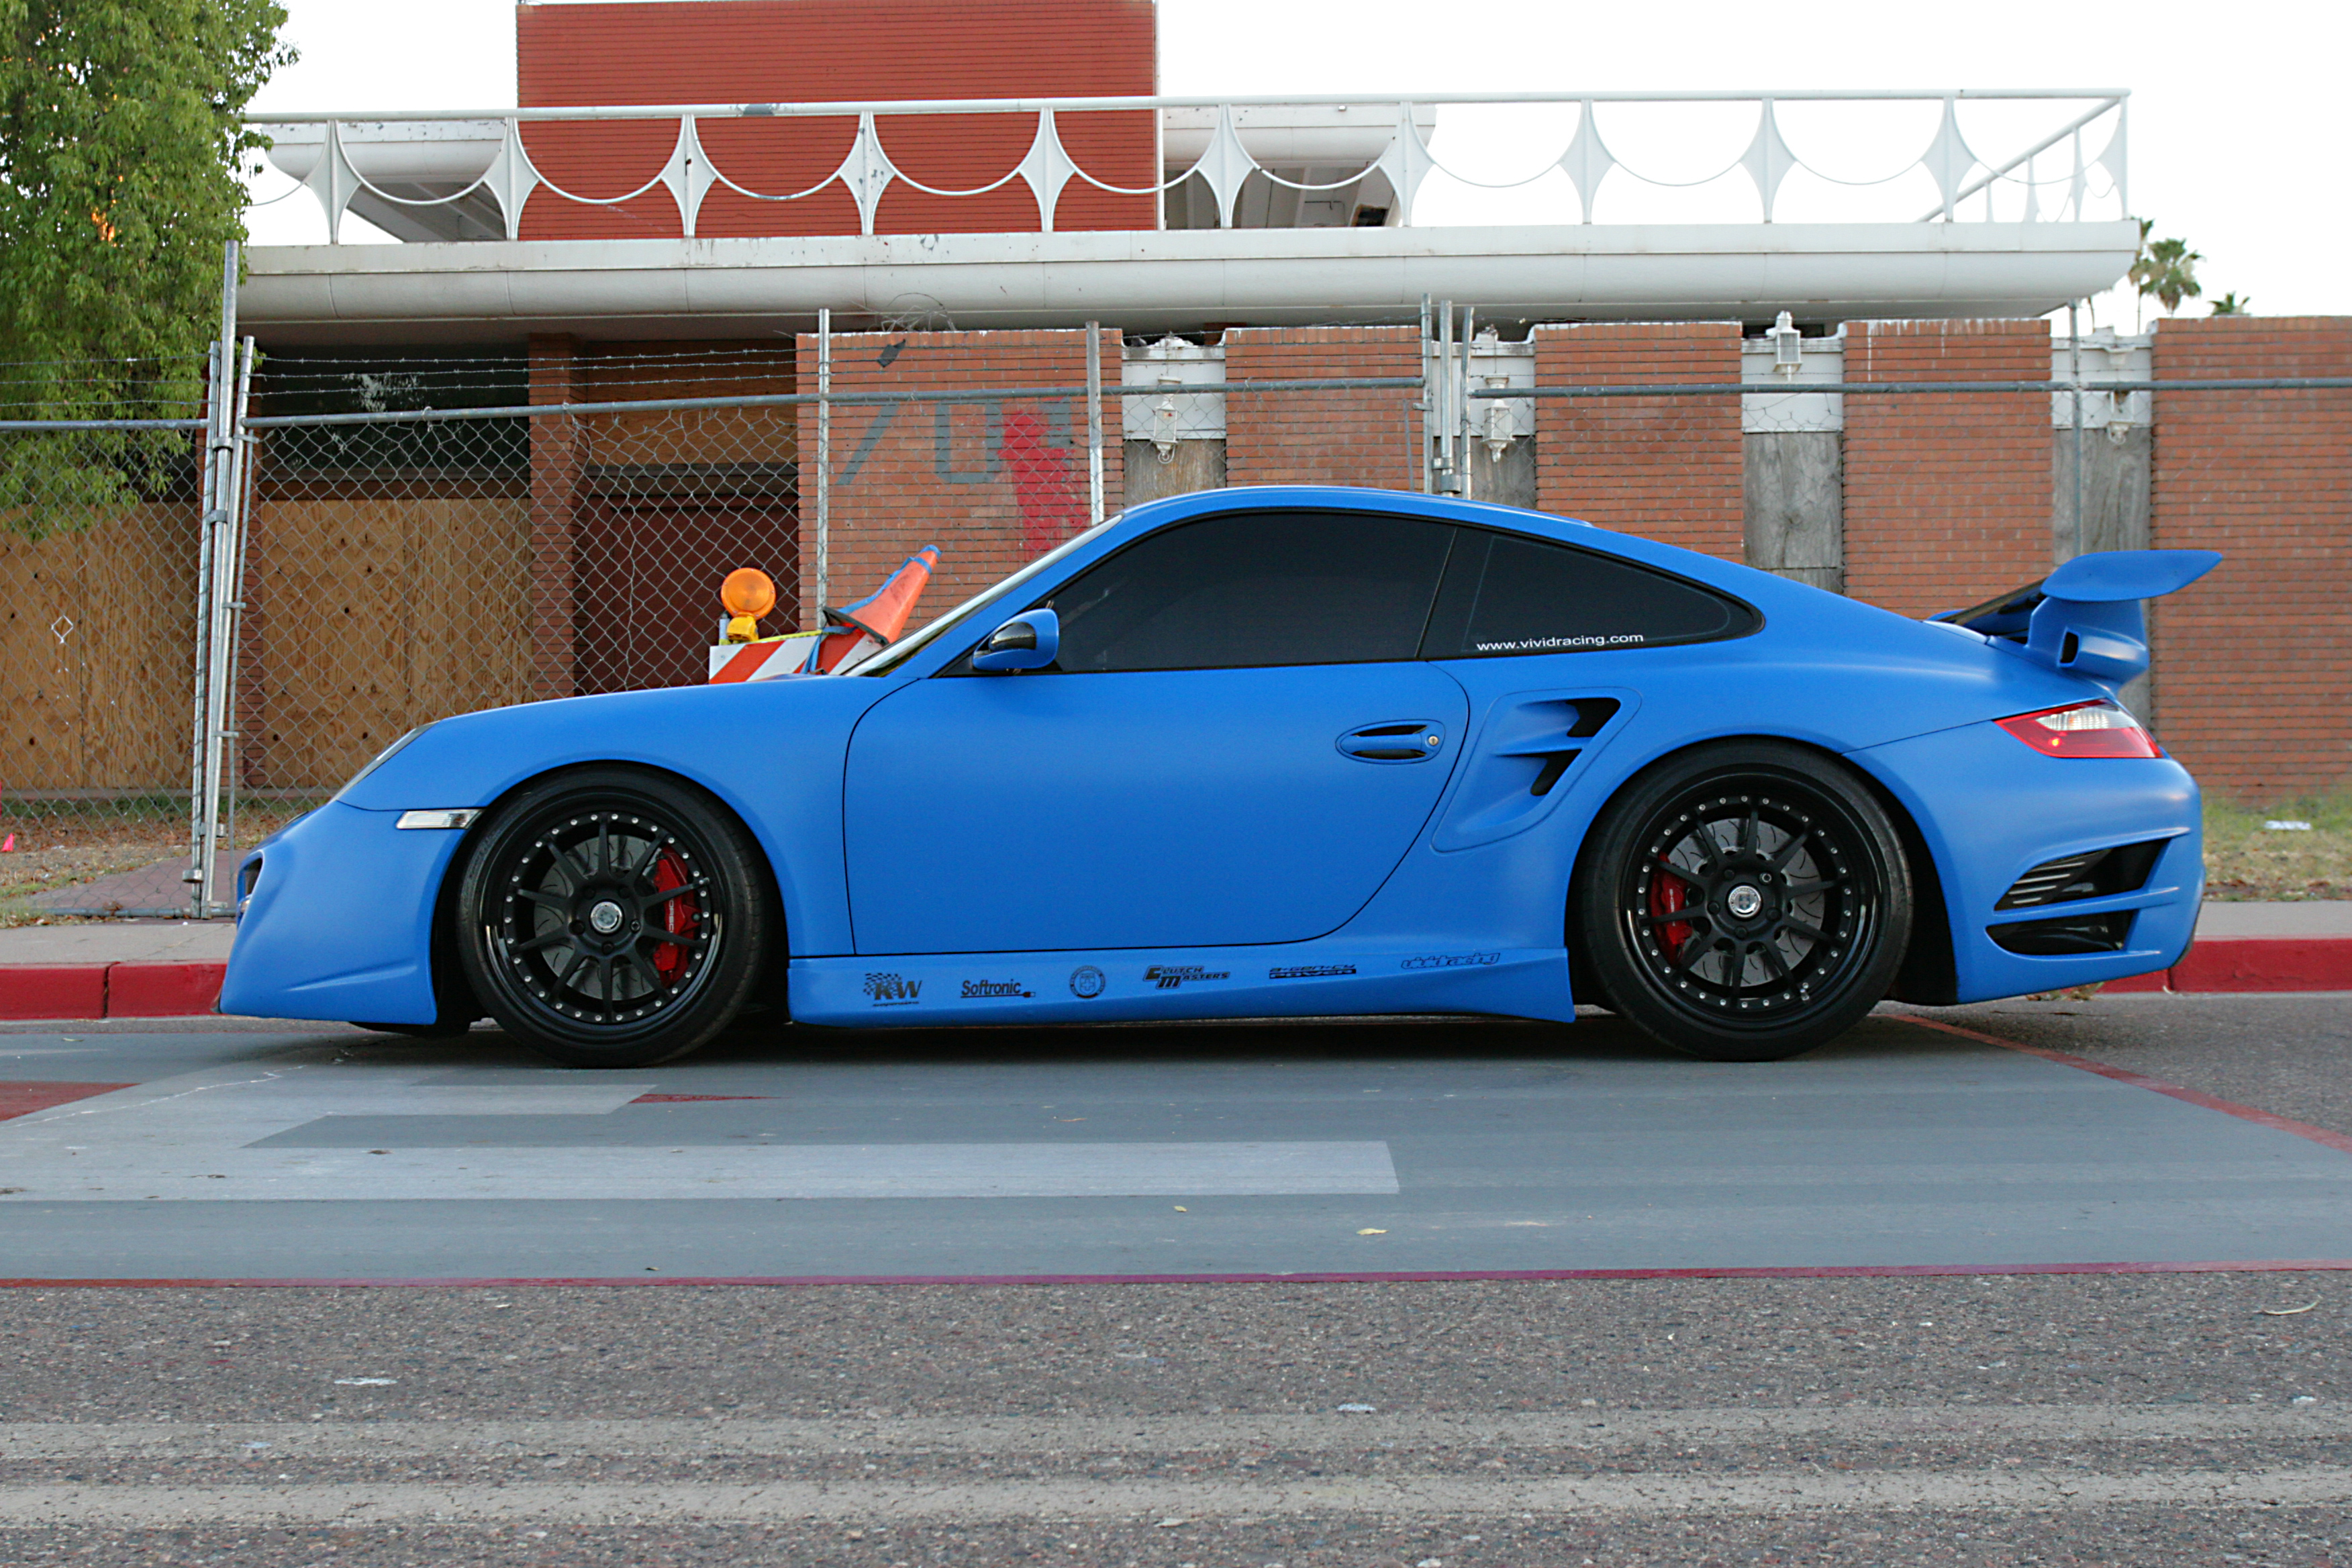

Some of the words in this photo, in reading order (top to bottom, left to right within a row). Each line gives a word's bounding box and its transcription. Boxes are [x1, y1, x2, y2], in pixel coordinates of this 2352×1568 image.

[1477, 634, 1644, 651] www.vividracing.com
[1144, 966, 1204, 981] CLUTCH
[1157, 972, 1229, 988] MASTERS
[875, 980, 922, 1000] KW
[961, 979, 1021, 995] Softronic
